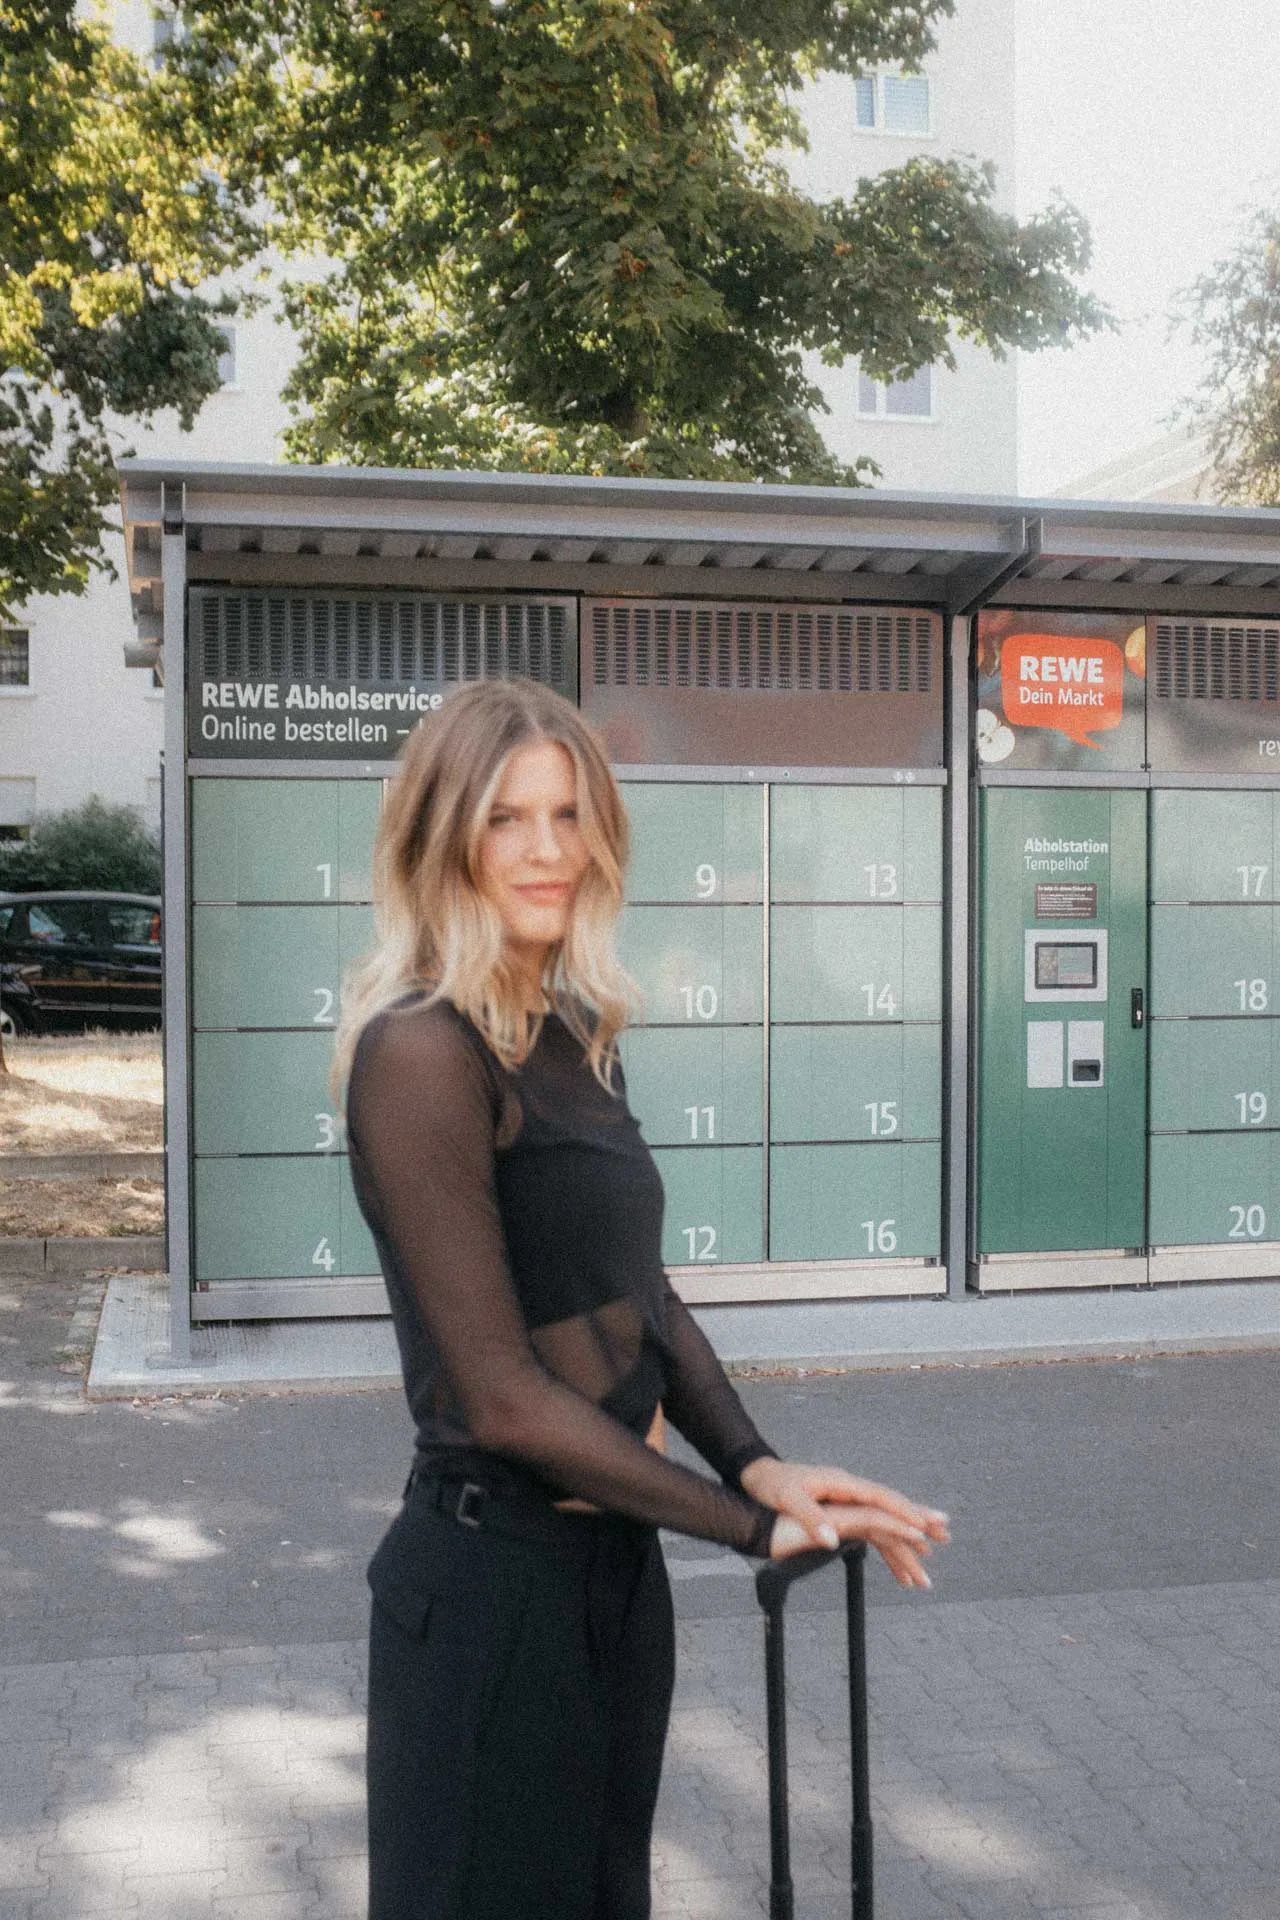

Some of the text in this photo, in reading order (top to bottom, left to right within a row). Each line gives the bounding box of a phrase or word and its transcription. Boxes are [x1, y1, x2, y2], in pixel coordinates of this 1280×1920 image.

[1019, 655, 1104, 684] REWE
[202, 682, 443, 712] REWE Abholservice
[1019, 686, 1105, 706] Dein Markt
[201, 714, 276, 741] Online
[284, 716, 388, 743] bestellen
[1258, 740, 1280, 756] re
[1024, 838, 1109, 853] Abholstation
[316, 863, 331, 897] 1
[695, 863, 717, 898] 9
[863, 863, 897, 897] 13
[1024, 856, 1089, 874] Tempelhof
[1236, 865, 1268, 897] 17
[313, 988, 333, 1023] 2
[679, 984, 718, 1019] 10
[860, 983, 897, 1016] 14
[1233, 978, 1268, 1011] 18
[684, 1105, 715, 1140] 11
[864, 1101, 897, 1135] 15
[1233, 1091, 1268, 1124] 19
[315, 1112, 334, 1149] 3
[860, 1219, 897, 1253] 16
[1228, 1204, 1266, 1238] 20
[311, 1236, 335, 1271] 4
[681, 1225, 718, 1260] 12
